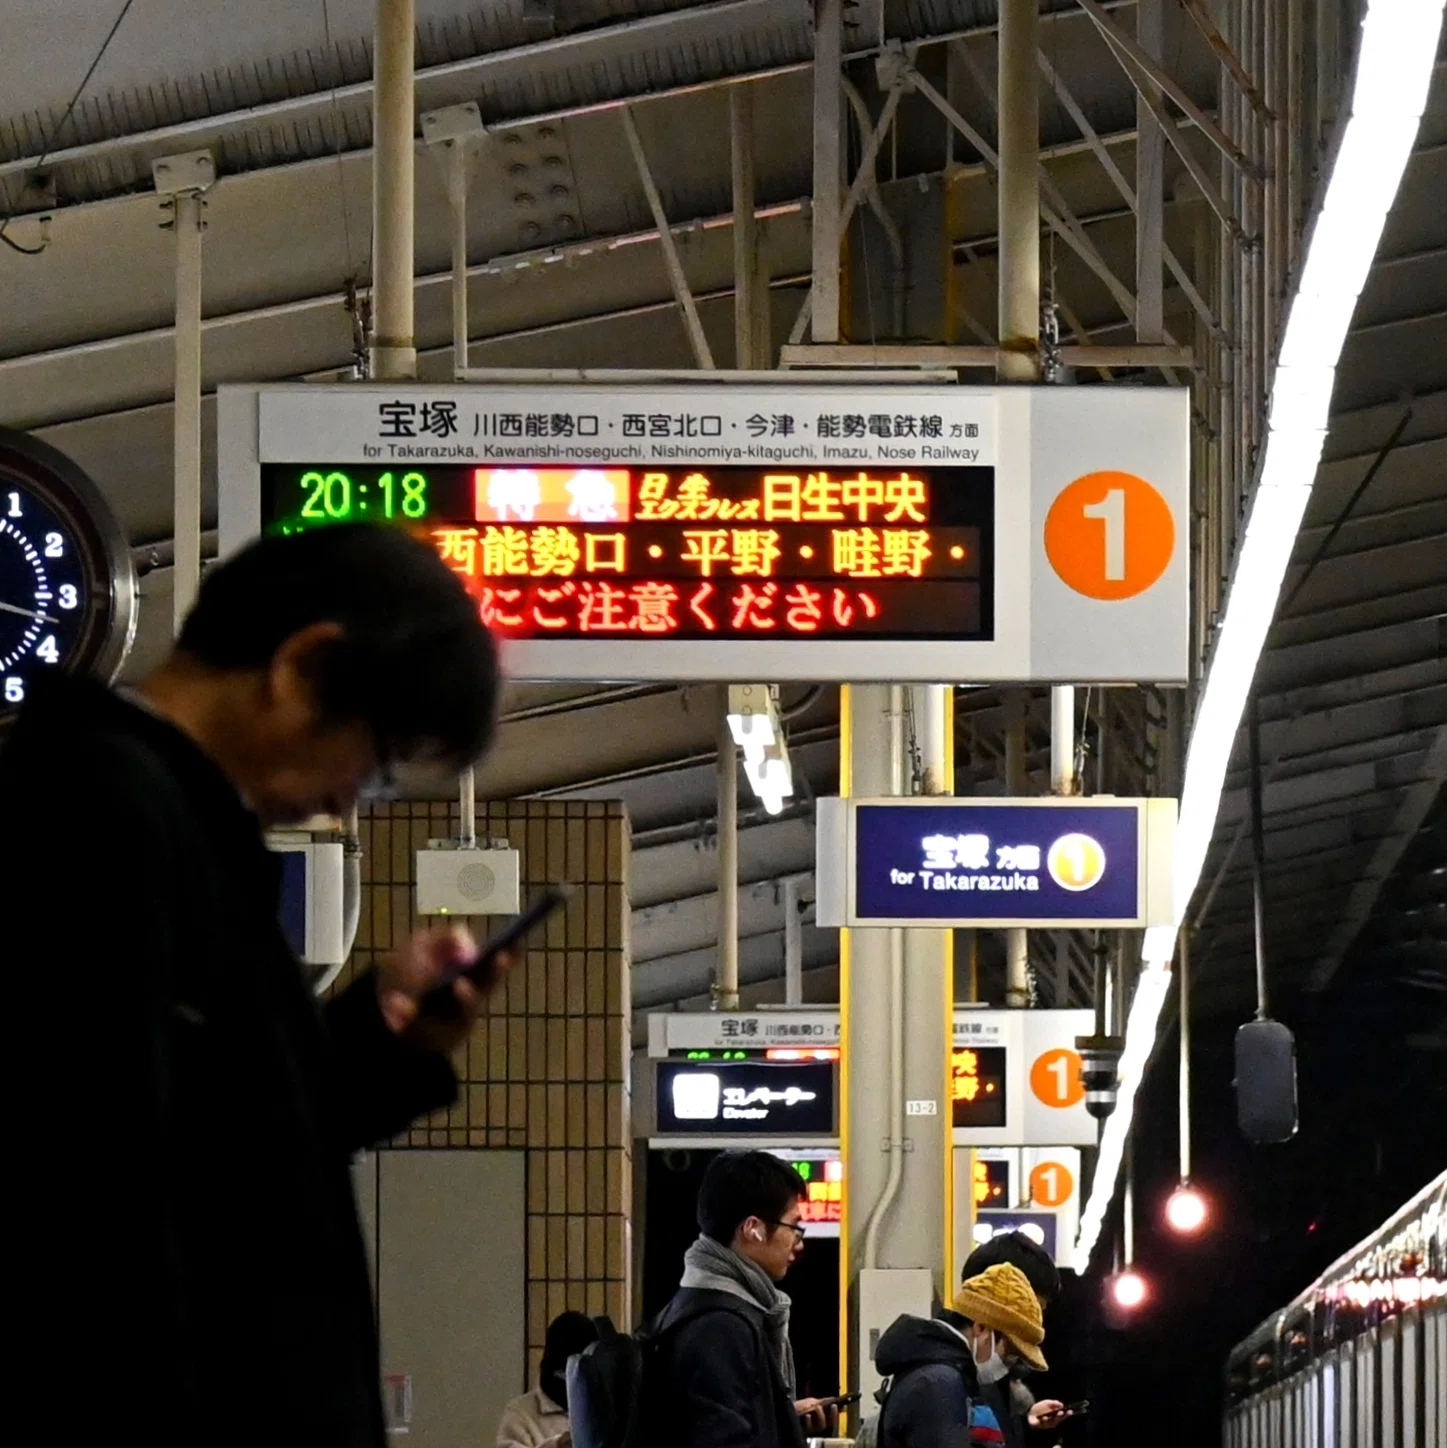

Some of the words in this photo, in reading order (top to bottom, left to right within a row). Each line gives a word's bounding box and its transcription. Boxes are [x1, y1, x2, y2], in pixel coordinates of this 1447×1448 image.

[378, 400, 458, 439] 宝塚
[949, 423, 979, 438] 方面
[363, 443, 383, 458] for
[387, 443, 479, 460] Takarazuka,
[484, 443, 647, 461] Kawanishi-noseguchi,
[651, 443, 818, 461] Nishinomiya-kitaguchi,
[822, 444, 873, 460] Imazu,
[877, 445, 917, 460] Nose
[921, 445, 979, 461] Railway
[7, 492, 23, 518] 1
[300, 472, 427, 519] 20:18
[762, 471, 927, 523] 日生中央
[44, 532, 63, 558] 2
[1083, 489, 1126, 580] 1
[58, 584, 78, 609] 3
[36, 635, 60, 663] 4
[4, 677, 24, 702] 5
[890, 868, 915, 886] for
[919, 871, 1039, 891] Takarazuka
[1047, 1056, 1069, 1100] 1
[909, 1102, 935, 1114] 13-2
[1040, 1167, 1058, 1202] 1
